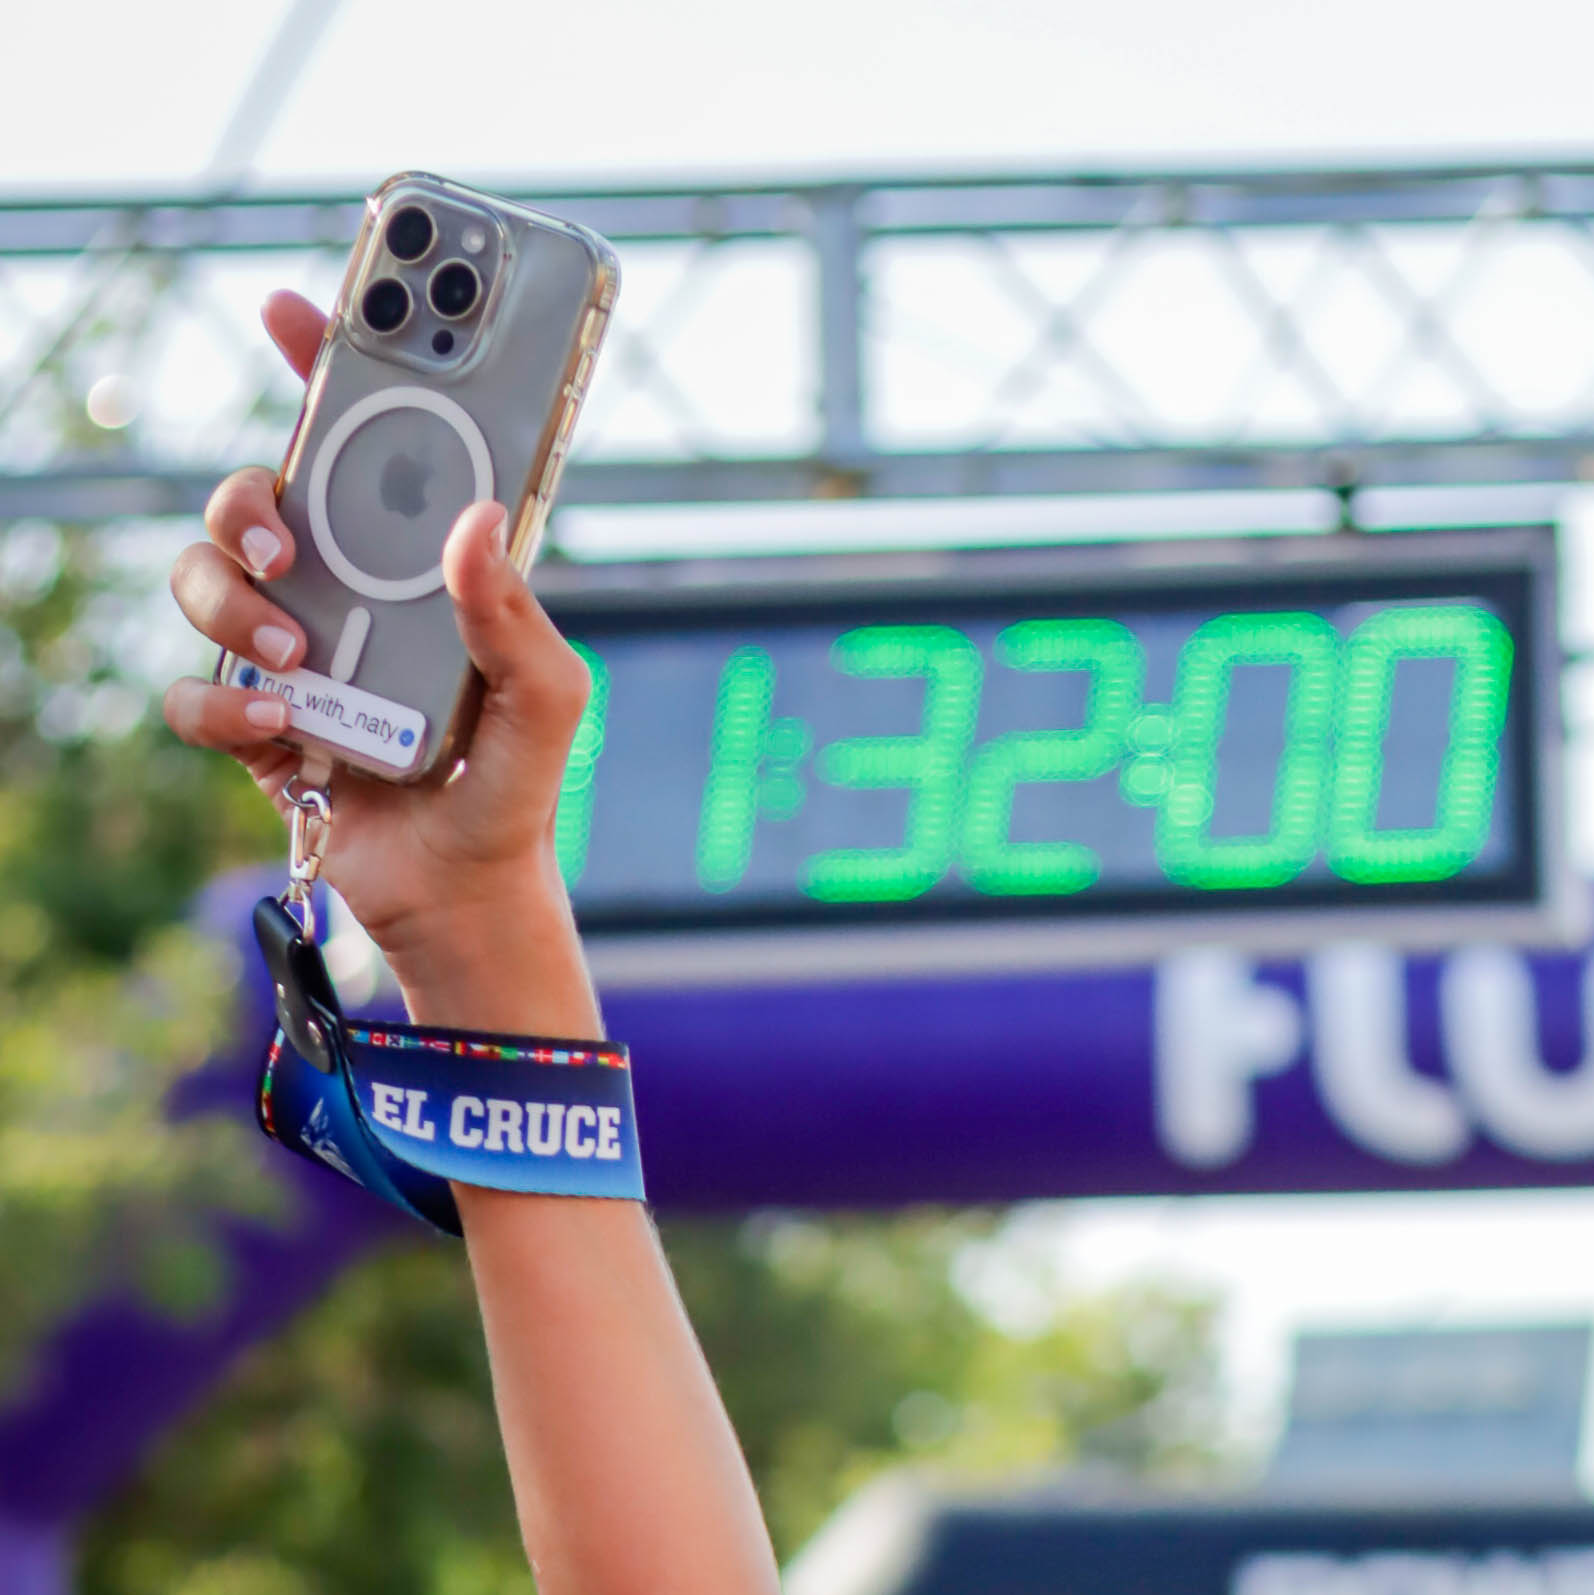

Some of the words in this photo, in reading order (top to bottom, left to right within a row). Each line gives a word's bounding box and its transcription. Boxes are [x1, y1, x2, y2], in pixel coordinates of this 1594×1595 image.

[263, 675, 399, 744] run_with_naty
[371, 1081, 435, 1142] EL
[449, 1095, 622, 1161] CRUCE
